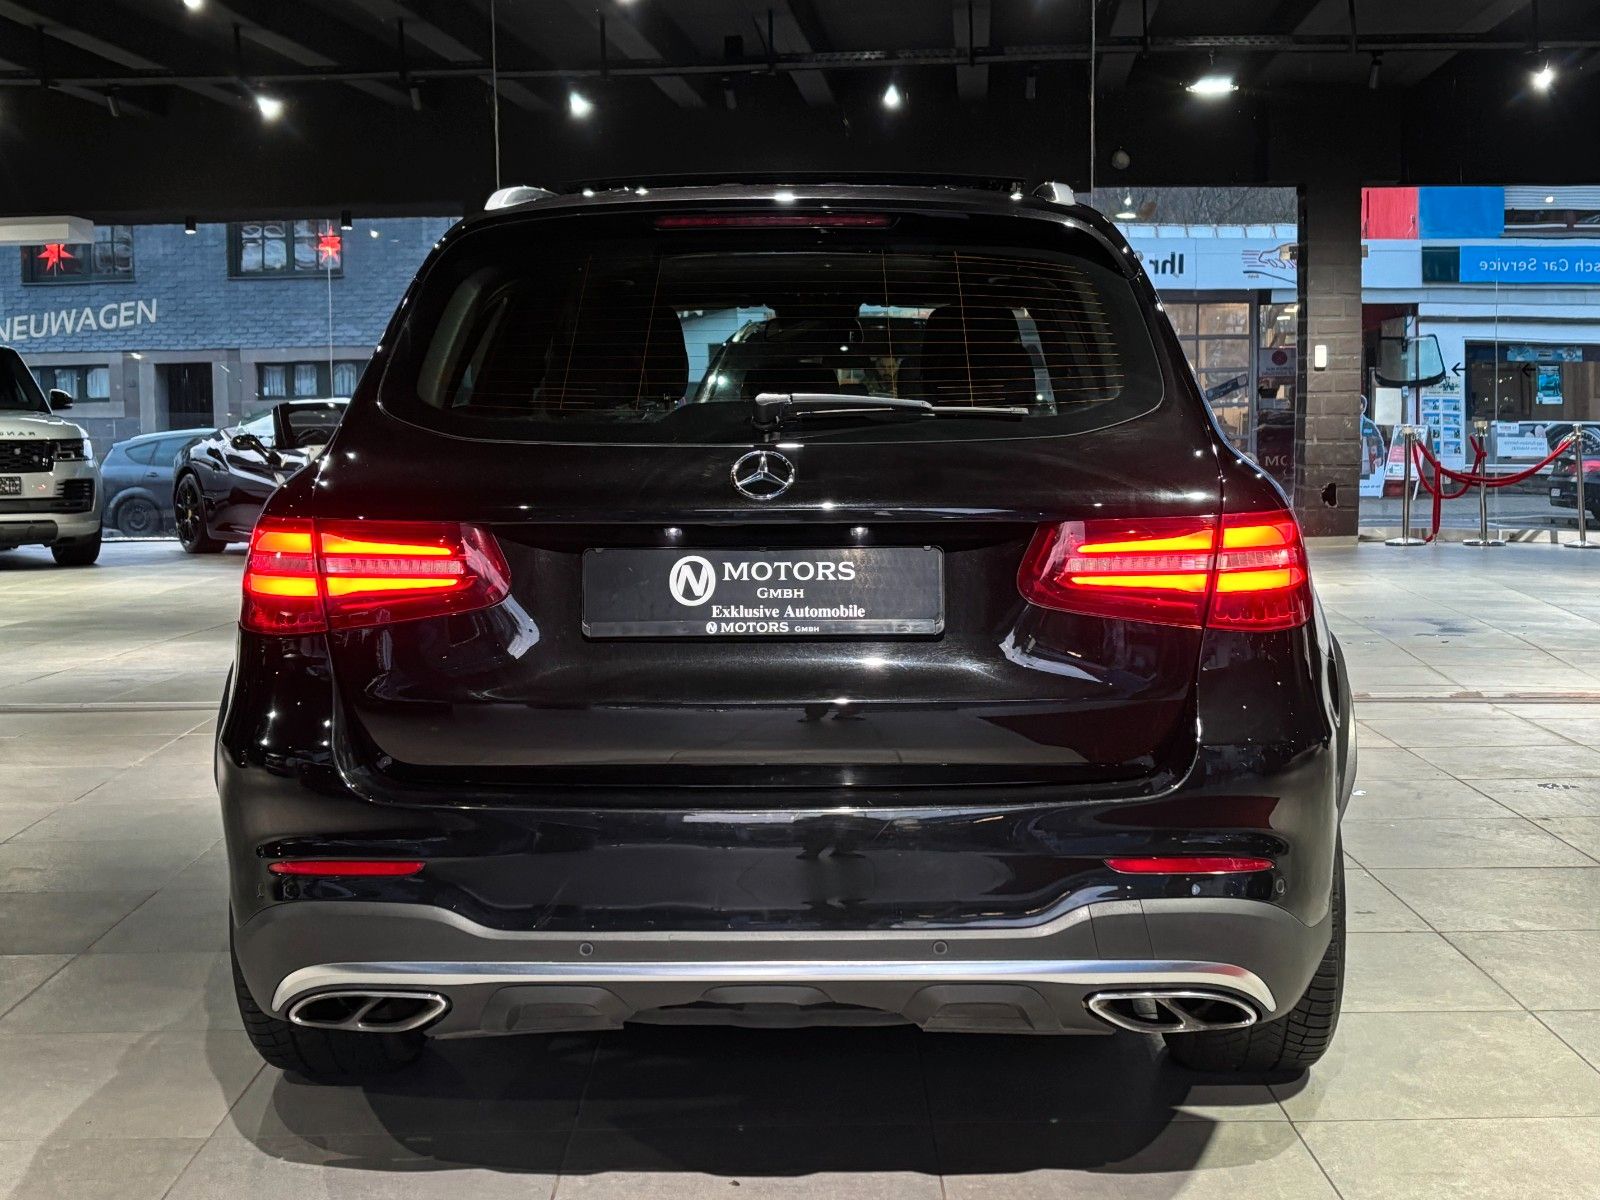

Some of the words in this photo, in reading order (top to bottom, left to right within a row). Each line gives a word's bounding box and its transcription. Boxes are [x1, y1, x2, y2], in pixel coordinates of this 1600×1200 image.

[722, 561, 856, 581] MOTORS
[757, 587, 804, 599] GMBH
[711, 605, 780, 618] Exklusive
[784, 605, 866, 618] Automobile
[720, 622, 789, 633] MOTORS
